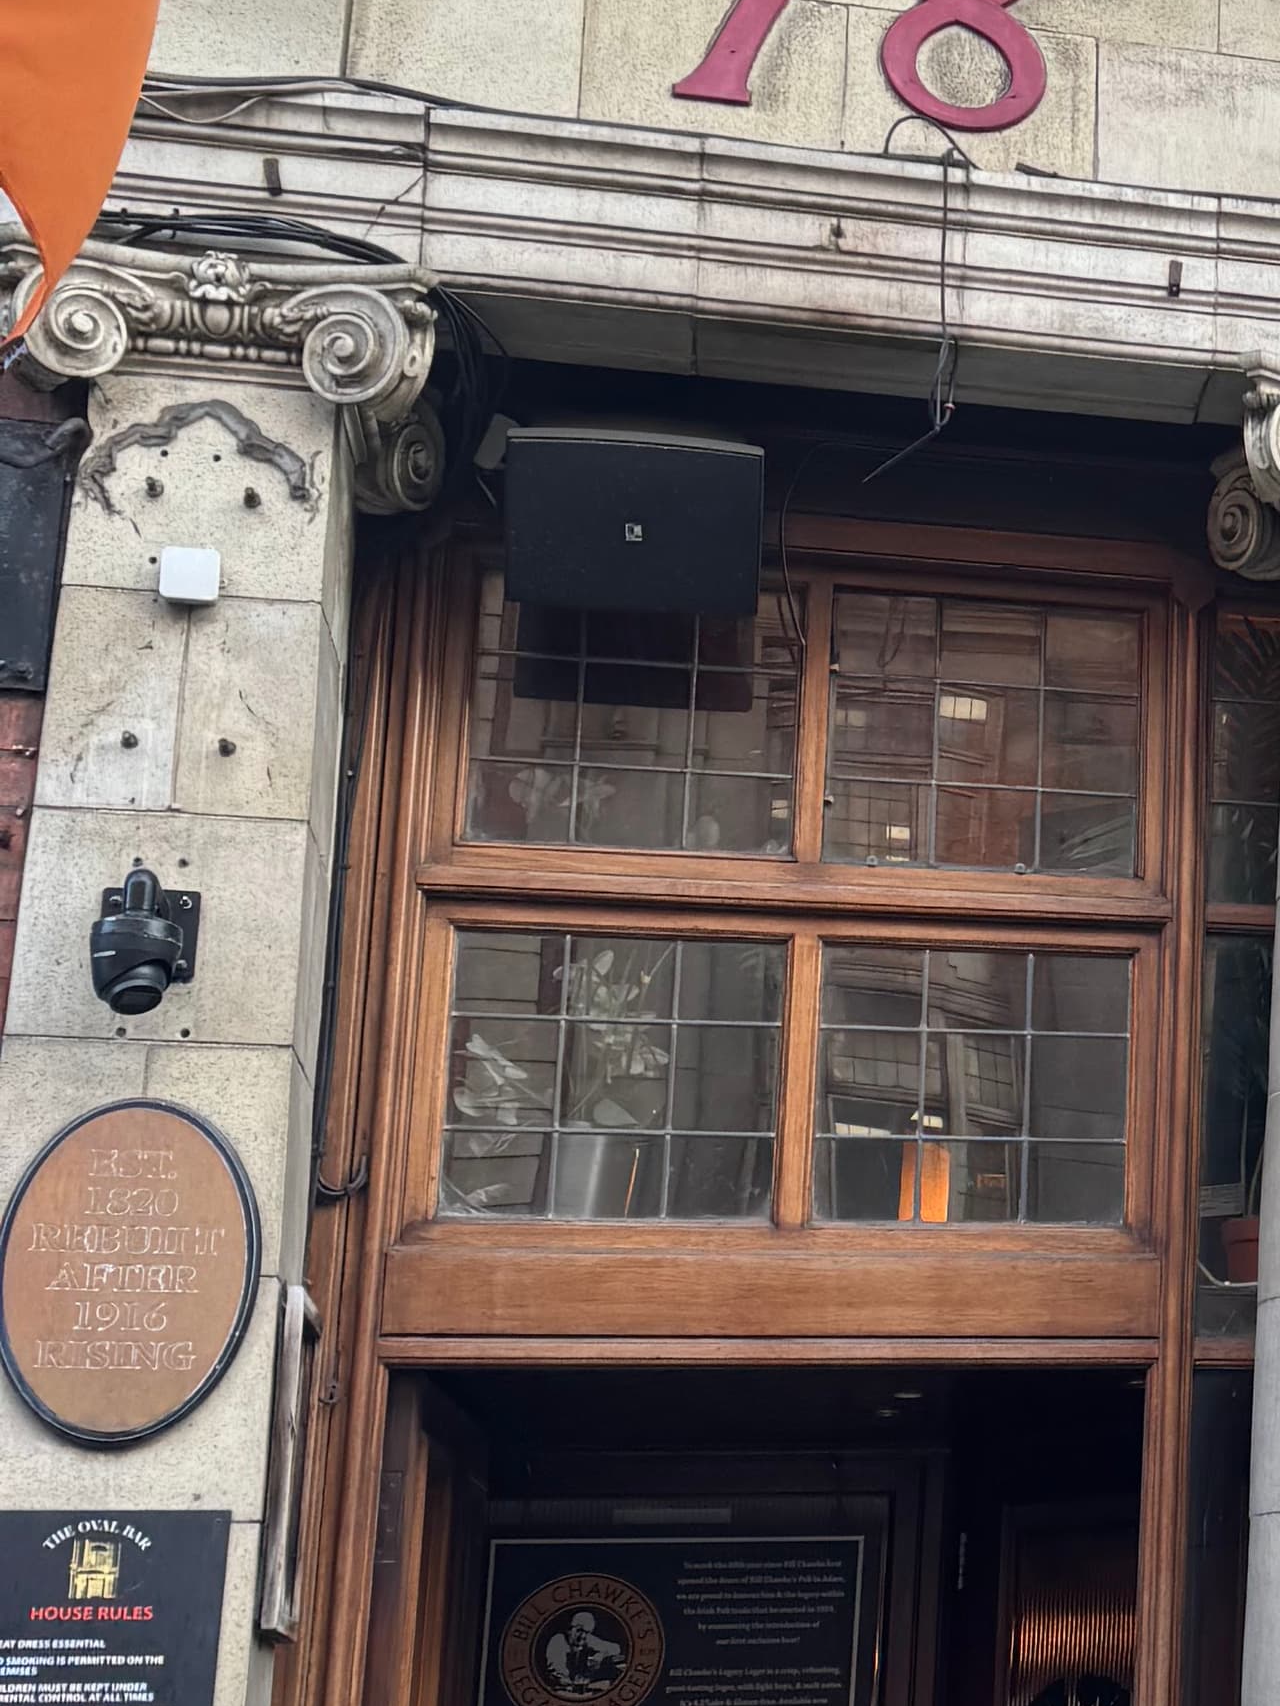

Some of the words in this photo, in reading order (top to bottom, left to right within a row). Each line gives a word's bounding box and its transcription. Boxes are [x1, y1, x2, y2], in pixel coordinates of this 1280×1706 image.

[88, 1148, 178, 1180] EST.
[84, 1186, 179, 1217] 1820
[28, 1223, 225, 1256] REBUILT
[45, 1262, 200, 1293] AFTER
[72, 1301, 168, 1332] 1916
[33, 1339, 197, 1370] RISING
[42, 1525, 75, 1550] THE
[77, 1519, 119, 1534] OVAL
[122, 1525, 152, 1551] BAR
[29, 1606, 94, 1621] HOUSE
[97, 1605, 154, 1621] RULES
[512, 1603, 550, 1640] BILL
[551, 1580, 655, 1640] CHAWKE'S
[0, 1639, 16, 1649] EAT
[17, 1639, 51, 1649] DRESS
[52, 1638, 106, 1649] ESSENTIAL
[0, 1666, 38, 1677] EMISES
[6, 1656, 55, 1667] SMOKING
[56, 1656, 66, 1666] IS
[67, 1655, 126, 1666] PERMITTED
[127, 1655, 144, 1665] ON
[145, 1655, 165, 1665] THE
[0, 1683, 36, 1693] ILDREN
[38, 1683, 69, 1693] MUST
[69, 1683, 82, 1692] BE
[83, 1683, 110, 1692] KEPT
[111, 1682, 148, 1692] UNDER
[0, 1693, 36, 1704] RENTAL
[38, 1693, 87, 1703] CONTROL
[87, 1693, 102, 1703] AT
[102, 1693, 122, 1702] ALL
[124, 1692, 155, 1702] TIMES
